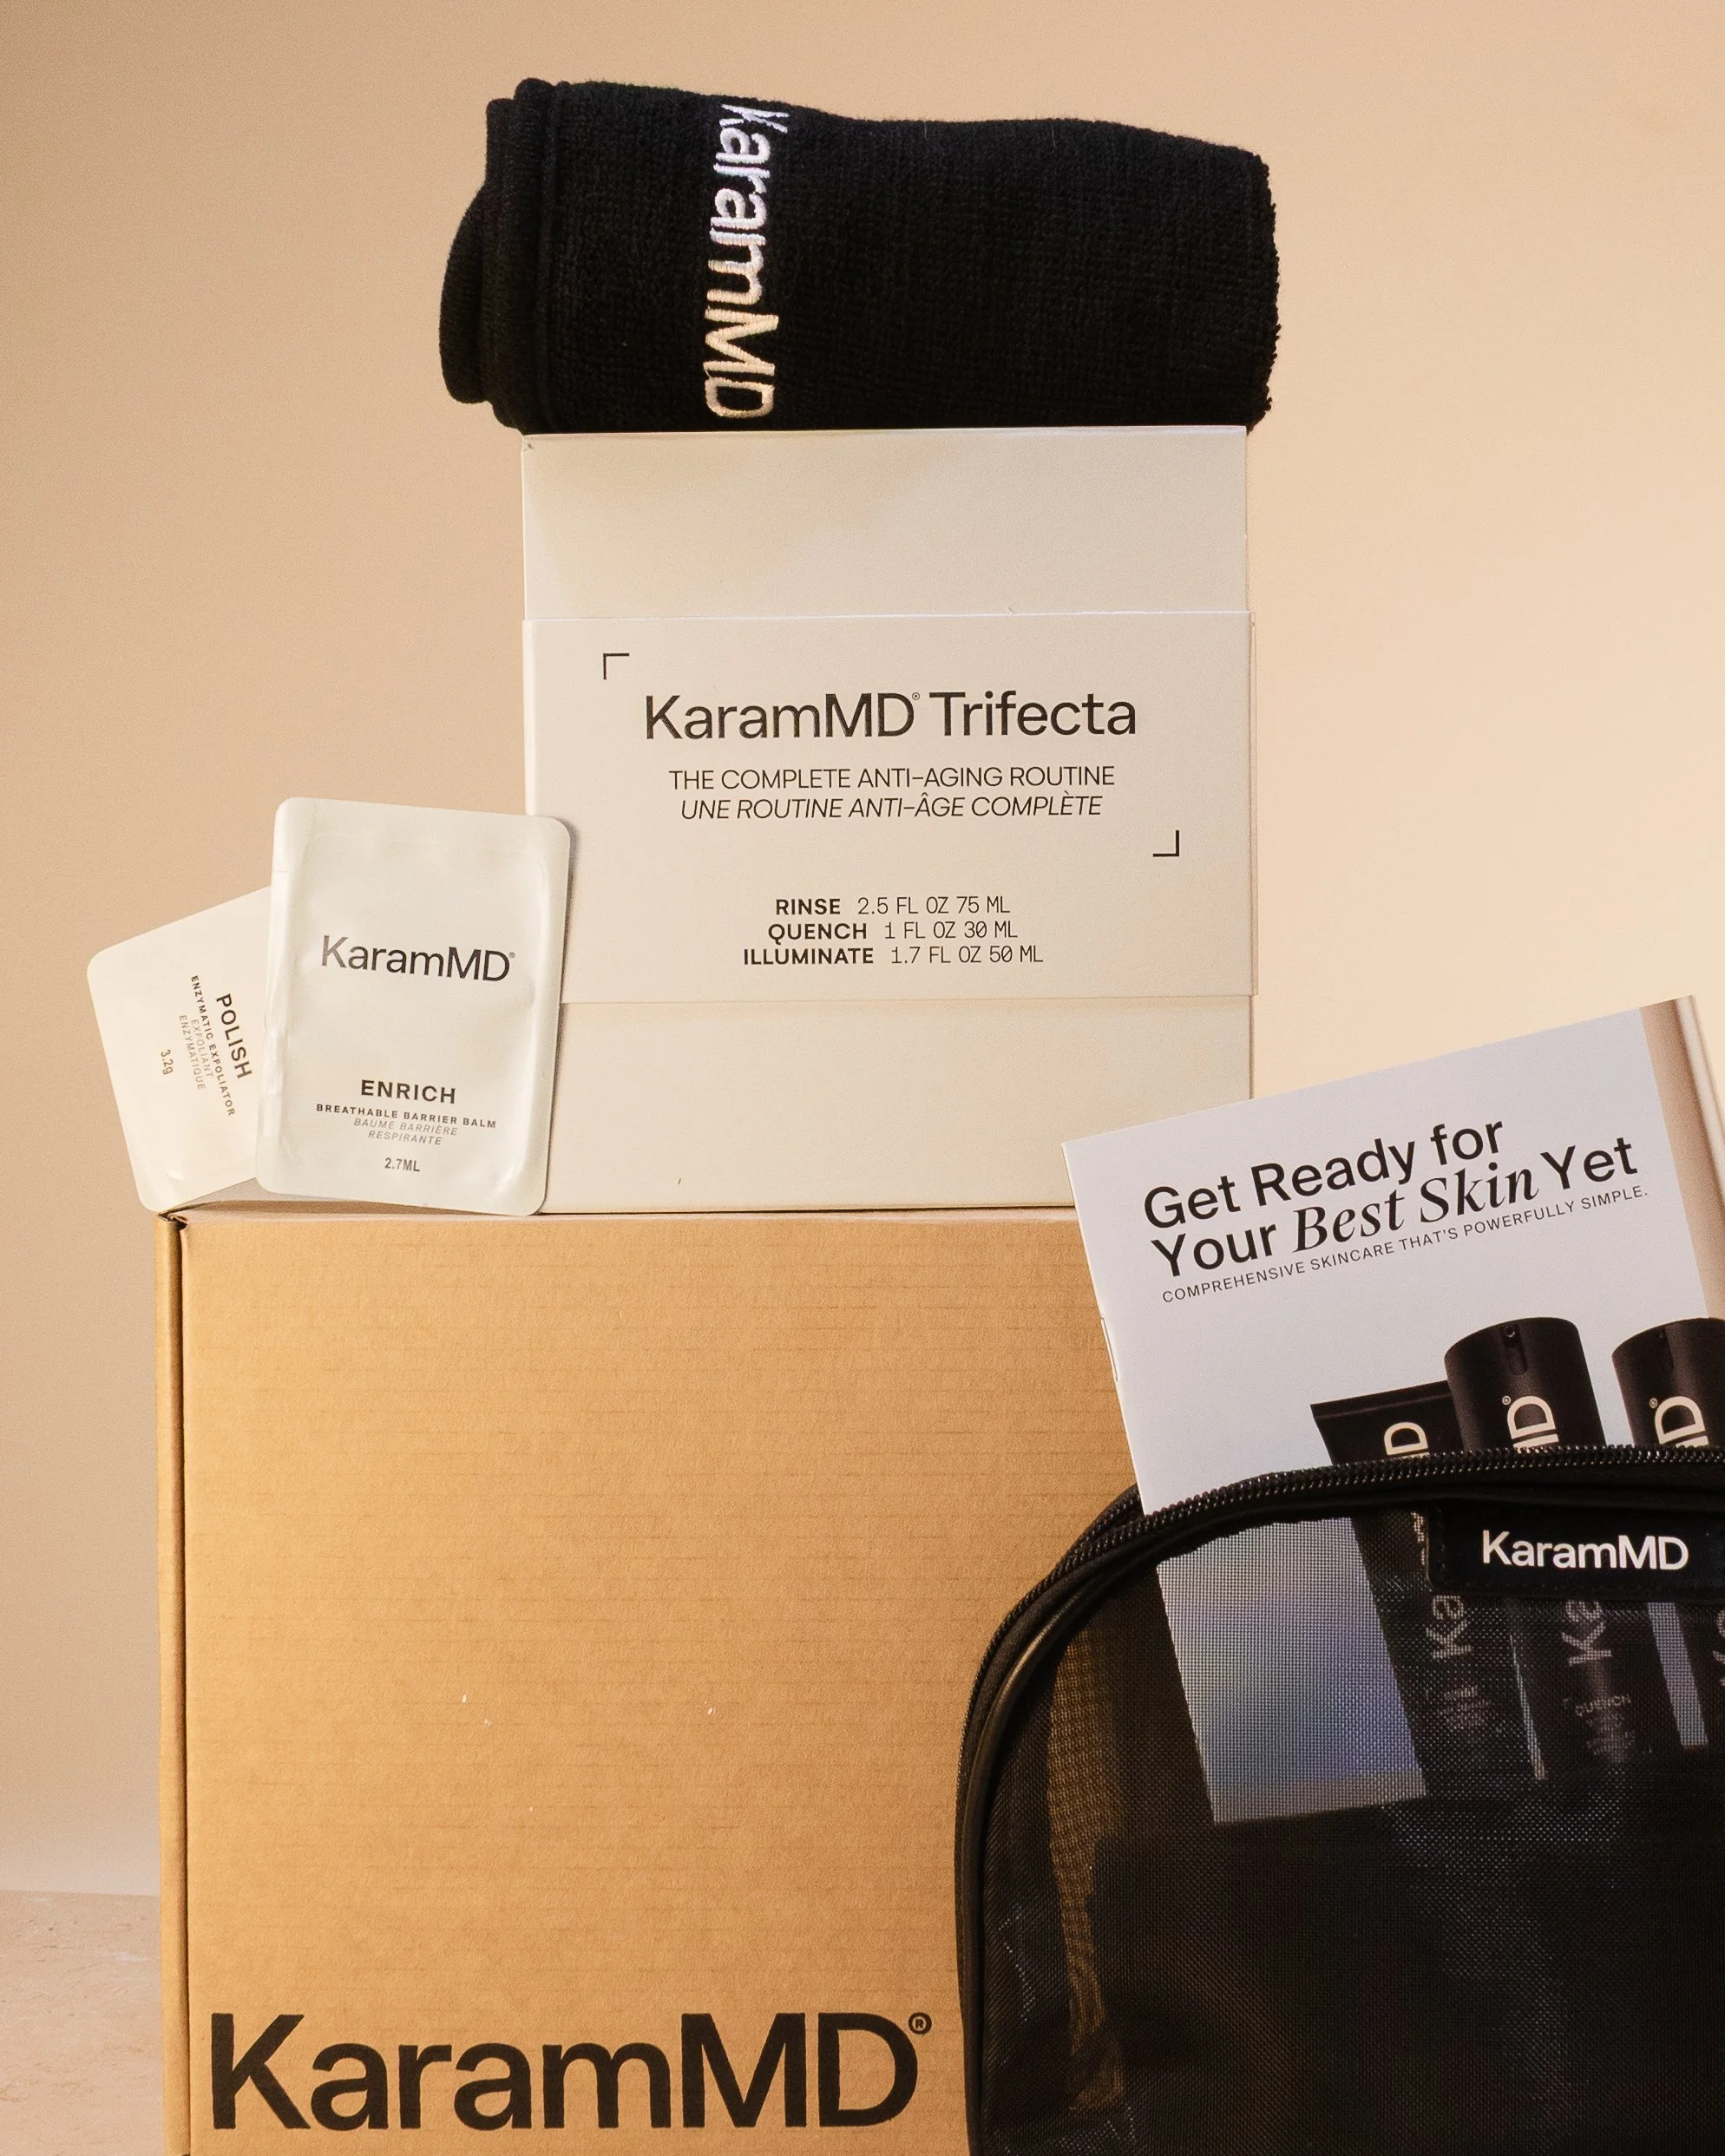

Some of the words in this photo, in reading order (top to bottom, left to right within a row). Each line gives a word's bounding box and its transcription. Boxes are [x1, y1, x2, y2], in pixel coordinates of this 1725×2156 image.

[704, 103, 790, 416] KaramMD
[929, 691, 1135, 736] Trifecta
[669, 770, 713, 790] THE
[722, 769, 850, 789] COMPLETE
[1011, 766, 1114, 786] ROUTINE
[682, 800, 731, 819] UNE
[738, 799, 843, 818] ROUTINE
[972, 790, 1102, 816] COMPLÈTE
[777, 899, 840, 914] RINSE
[858, 897, 888, 914] 2.5
[897, 897, 918, 914] FL
[927, 896, 948, 914] OZ
[957, 896, 979, 914] 75
[987, 896, 1010, 913] ML
[769, 923, 866, 945] QUENCH
[885, 922, 895, 939] 1
[904, 921, 925, 939] FL
[934, 921, 955, 938] OZ
[965, 921, 987, 938] 30
[995, 921, 1018, 938] ML
[744, 948, 873, 965] ILLUMINATE
[892, 947, 920, 963] 1.7
[929, 947, 951, 963] FL
[959, 946, 981, 963] OZ
[990, 946, 1013, 962] 50
[1020, 946, 1043, 962] ML
[191, 1019, 213, 1076] EXFOLIANT
[192, 976, 213, 1039] ENZYMATIC
[209, 1044, 234, 1115] EXFOLIATOR
[216, 993, 252, 1078] POLISH
[161, 1050, 174, 1075] 3.2g
[180, 1015, 206, 1089] ENZYMATIQUE
[362, 1080, 455, 1104] ENRICH
[317, 1104, 397, 1117] BREATHABLE
[403, 1112, 456, 1124] BARRIER
[463, 1117, 495, 1128] BALM
[354, 1118, 394, 1129] BAUME
[400, 1123, 457, 1136] BARRIÈRE
[369, 1130, 442, 1145] RESPIRANTE
[385, 1157, 420, 1172] 2.7ML
[1145, 1176, 1241, 1228] Get
[1251, 1138, 1414, 1206] Ready
[1430, 1122, 1502, 1165] for
[1151, 1224, 1276, 1276] Your
[1295, 1190, 1404, 1252] Best
[1420, 1163, 1537, 1222] Skin
[1540, 1137, 1637, 1189] Yet
[1163, 1262, 1304, 1302] COMPREHENSIVE
[1310, 1242, 1394, 1270] SKINCARE
[1399, 1228, 1458, 1249] THAT'S
[1464, 1201, 1573, 1235] POWERFULLY
[1581, 1186, 1647, 1209] SIMPLE.
[1483, 1530, 1689, 1569] KaramMD
